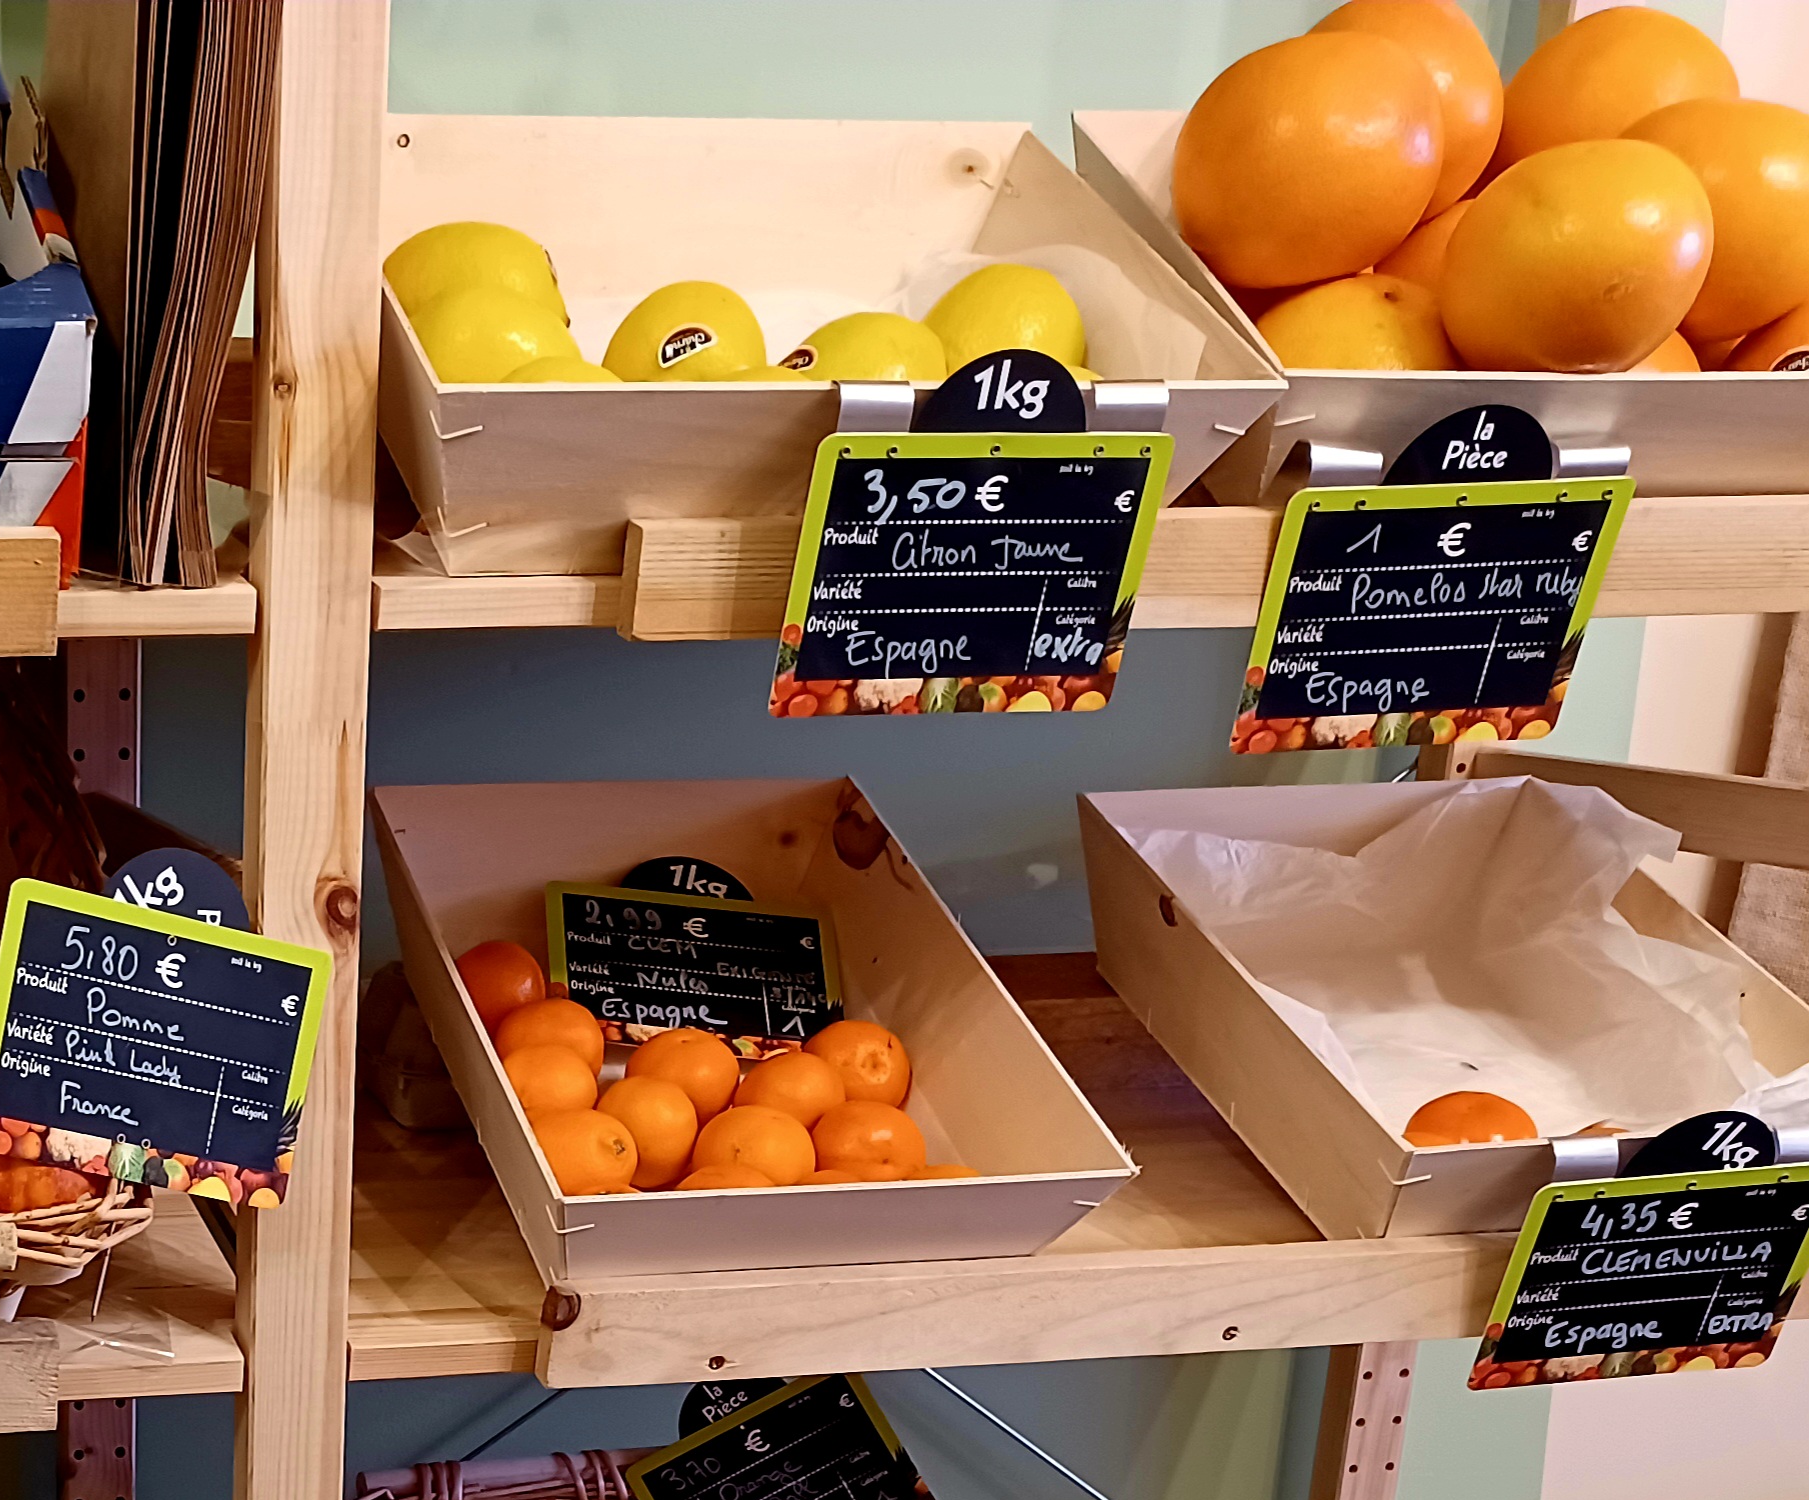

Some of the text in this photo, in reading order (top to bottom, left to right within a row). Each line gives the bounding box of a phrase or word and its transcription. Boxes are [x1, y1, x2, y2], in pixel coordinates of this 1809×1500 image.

[974, 358, 1051, 420] 1kg
[1473, 410, 1494, 441] la
[1441, 440, 1508, 470] Pièce
[864, 468, 1010, 526] 3,50 €
[823, 527, 879, 547] Produit
[892, 528, 977, 571] Citron
[1436, 522, 1472, 558] €
[813, 579, 864, 600] Variété
[1289, 574, 1343, 594] Produit
[1351, 572, 1466, 614] Pomelos
[807, 615, 860, 638] Origine
[1276, 622, 1325, 645] Variété
[845, 631, 972, 679] Espagne
[1033, 632, 1104, 665] extra
[1268, 657, 1320, 680] Origine
[1305, 672, 1431, 713] Espagne
[669, 864, 728, 899] 1kg
[566, 930, 613, 946] Produit
[682, 916, 710, 939] €
[60, 925, 187, 989] 5,80 €
[568, 960, 612, 976] Variété
[570, 979, 616, 995] Origine
[16, 967, 185, 1043] Produit Pomme
[281, 994, 301, 1017] €
[602, 998, 728, 1029] Espagne
[7, 1018, 55, 1046] Variété
[0, 1051, 52, 1079] Origine
[59, 1080, 140, 1127] France
[1700, 1120, 1760, 1170] 1kg
[1581, 1200, 1700, 1240] 4,35 €
[1529, 1248, 1580, 1267] Produit
[1515, 1286, 1560, 1306] Variété
[1507, 1313, 1554, 1331] Origine
[1544, 1320, 1663, 1354] Espagne
[701, 1388, 749, 1424] Pièce
[703, 1383, 723, 1401] la
[744, 1428, 771, 1453] €
